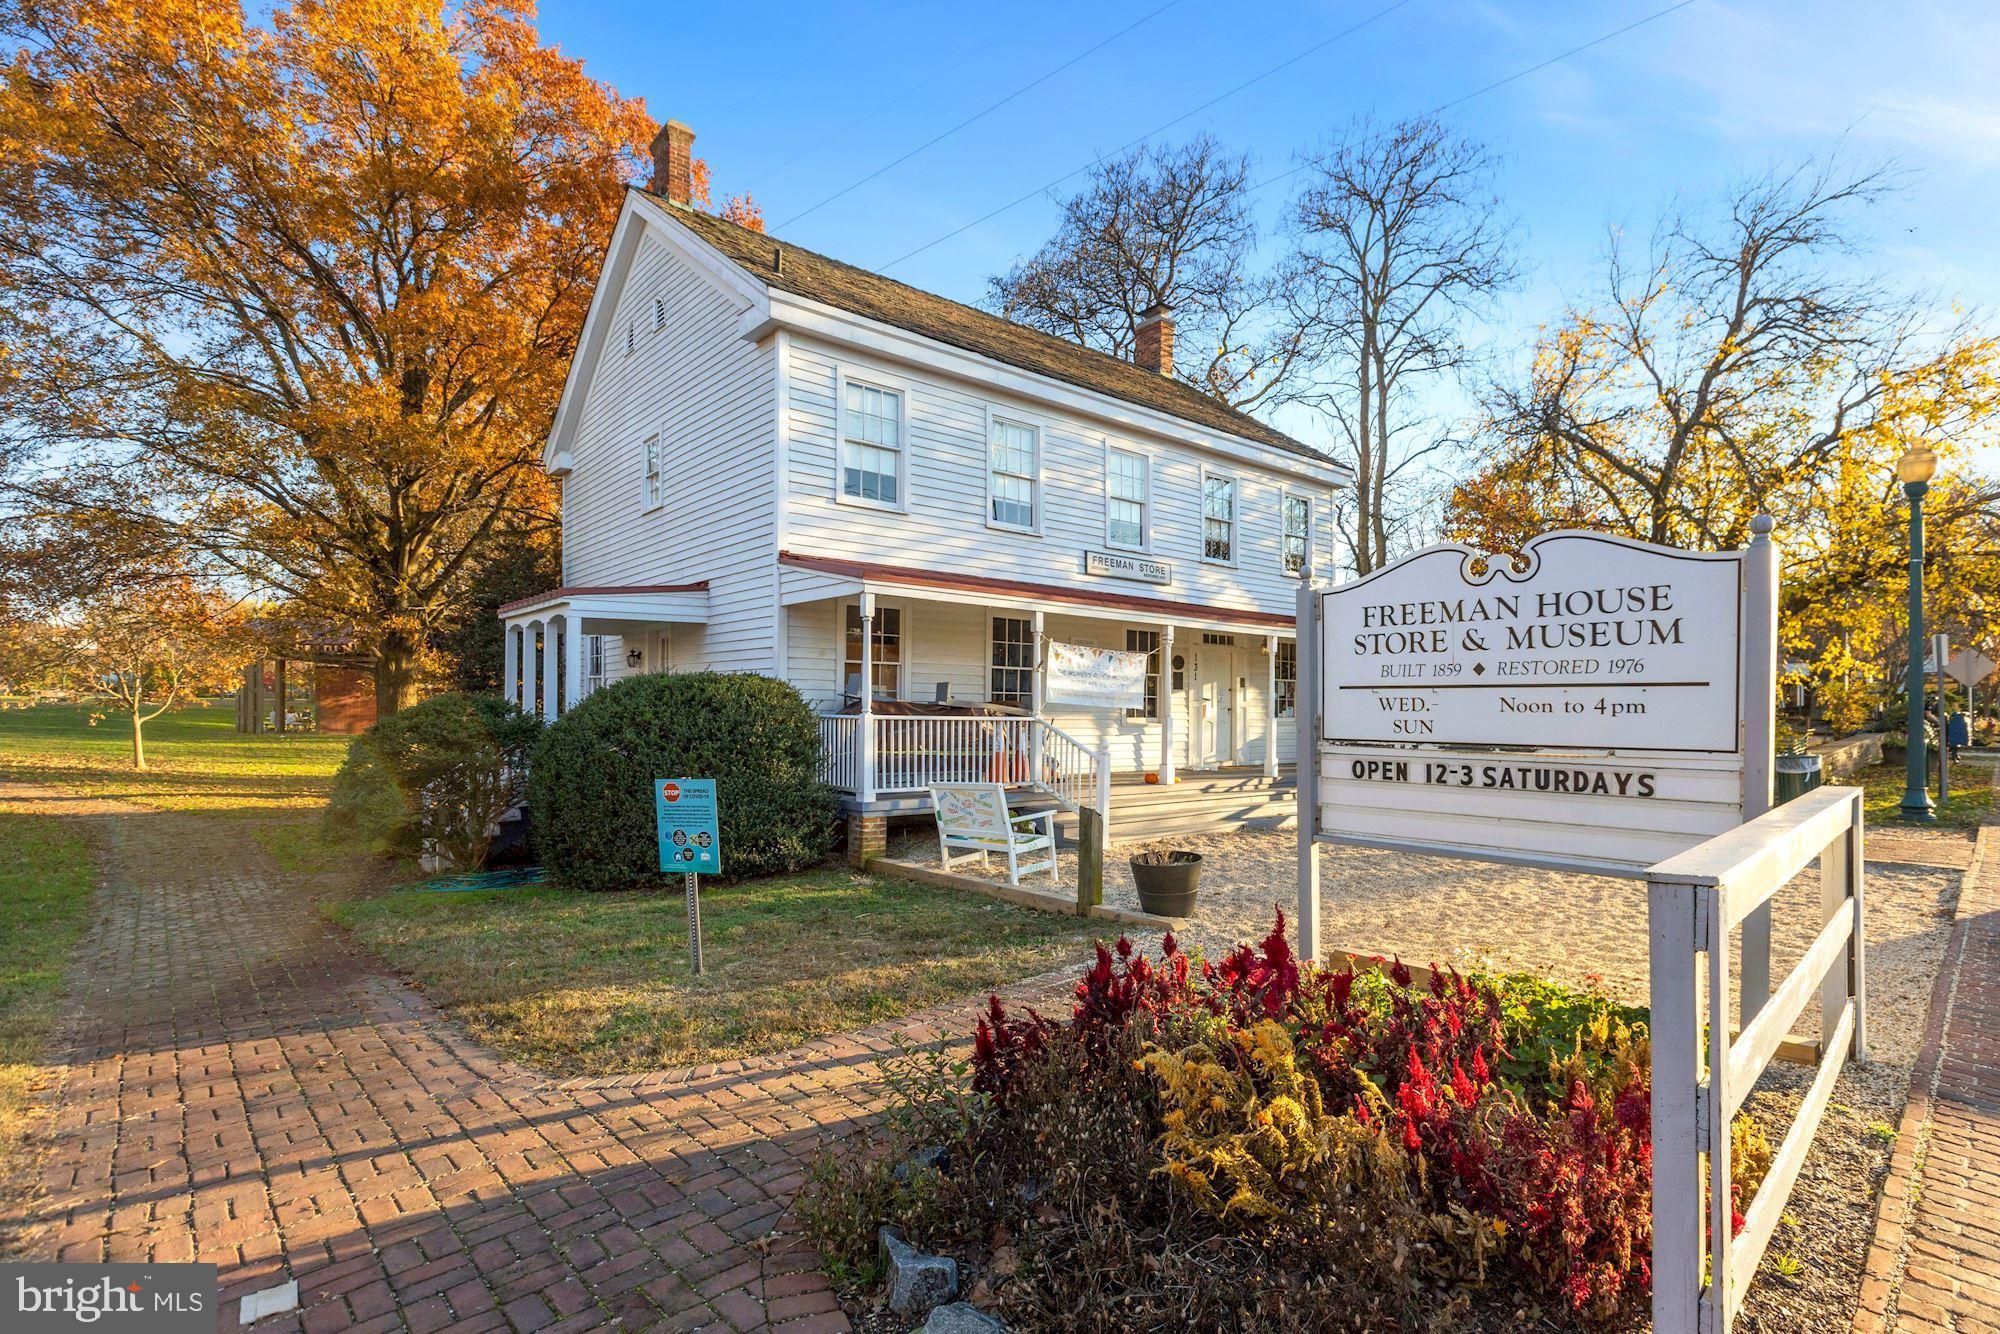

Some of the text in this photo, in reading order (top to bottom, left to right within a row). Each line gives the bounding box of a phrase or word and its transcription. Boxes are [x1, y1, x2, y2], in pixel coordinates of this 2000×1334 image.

[1092, 555, 1134, 571] FREEMAN
[1138, 563, 1166, 576] STORE
[1361, 584, 1674, 629] FREEMAN HOUSE
[1354, 617, 1686, 656] STORE & MUSEUM
[1380, 663, 1462, 678] BUILT 1859
[1497, 657, 1645, 676] RESTORED 1976
[1498, 697, 1554, 713] Noon
[1564, 700, 1585, 714] to
[1392, 719, 1434, 734] SUN
[1351, 760, 1656, 797] OPEN 12-3 SATURDAYS
